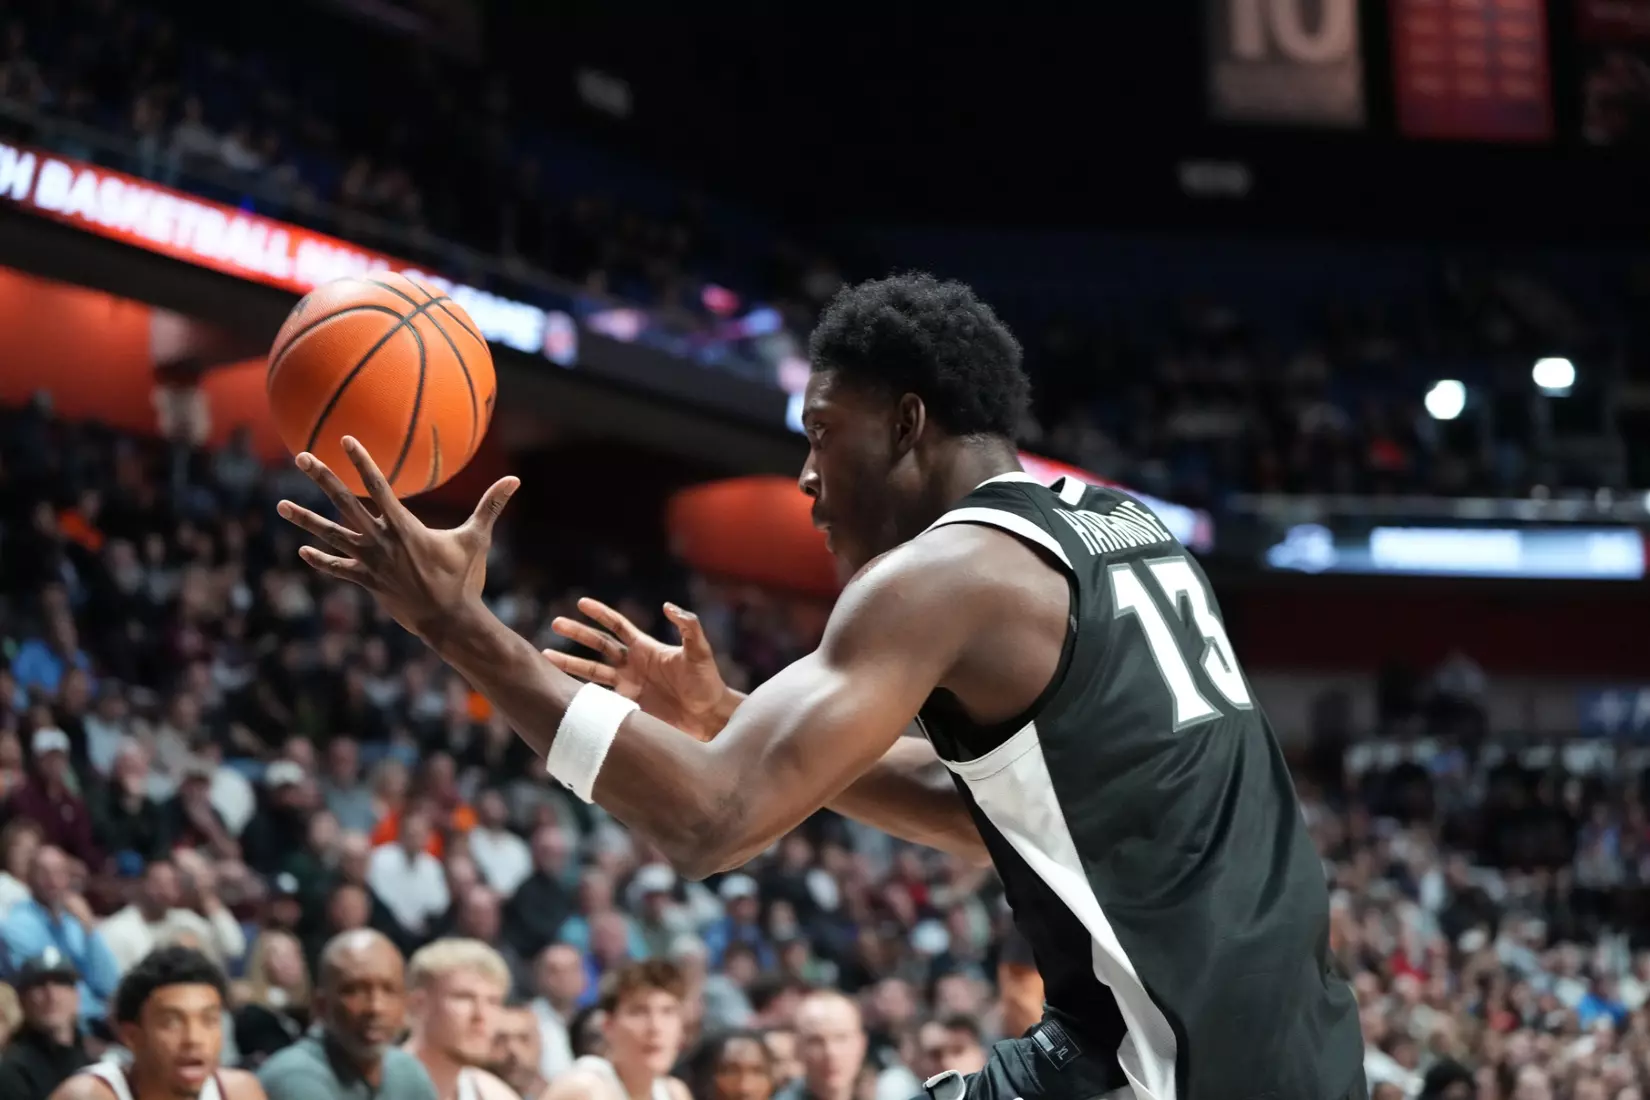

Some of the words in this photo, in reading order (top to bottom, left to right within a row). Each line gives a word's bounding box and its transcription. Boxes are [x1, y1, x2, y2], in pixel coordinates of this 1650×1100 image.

[35, 159, 292, 277] BASKETBALL
[1108, 556, 1253, 732] 13
[1055, 1045, 1069, 1060] XL
